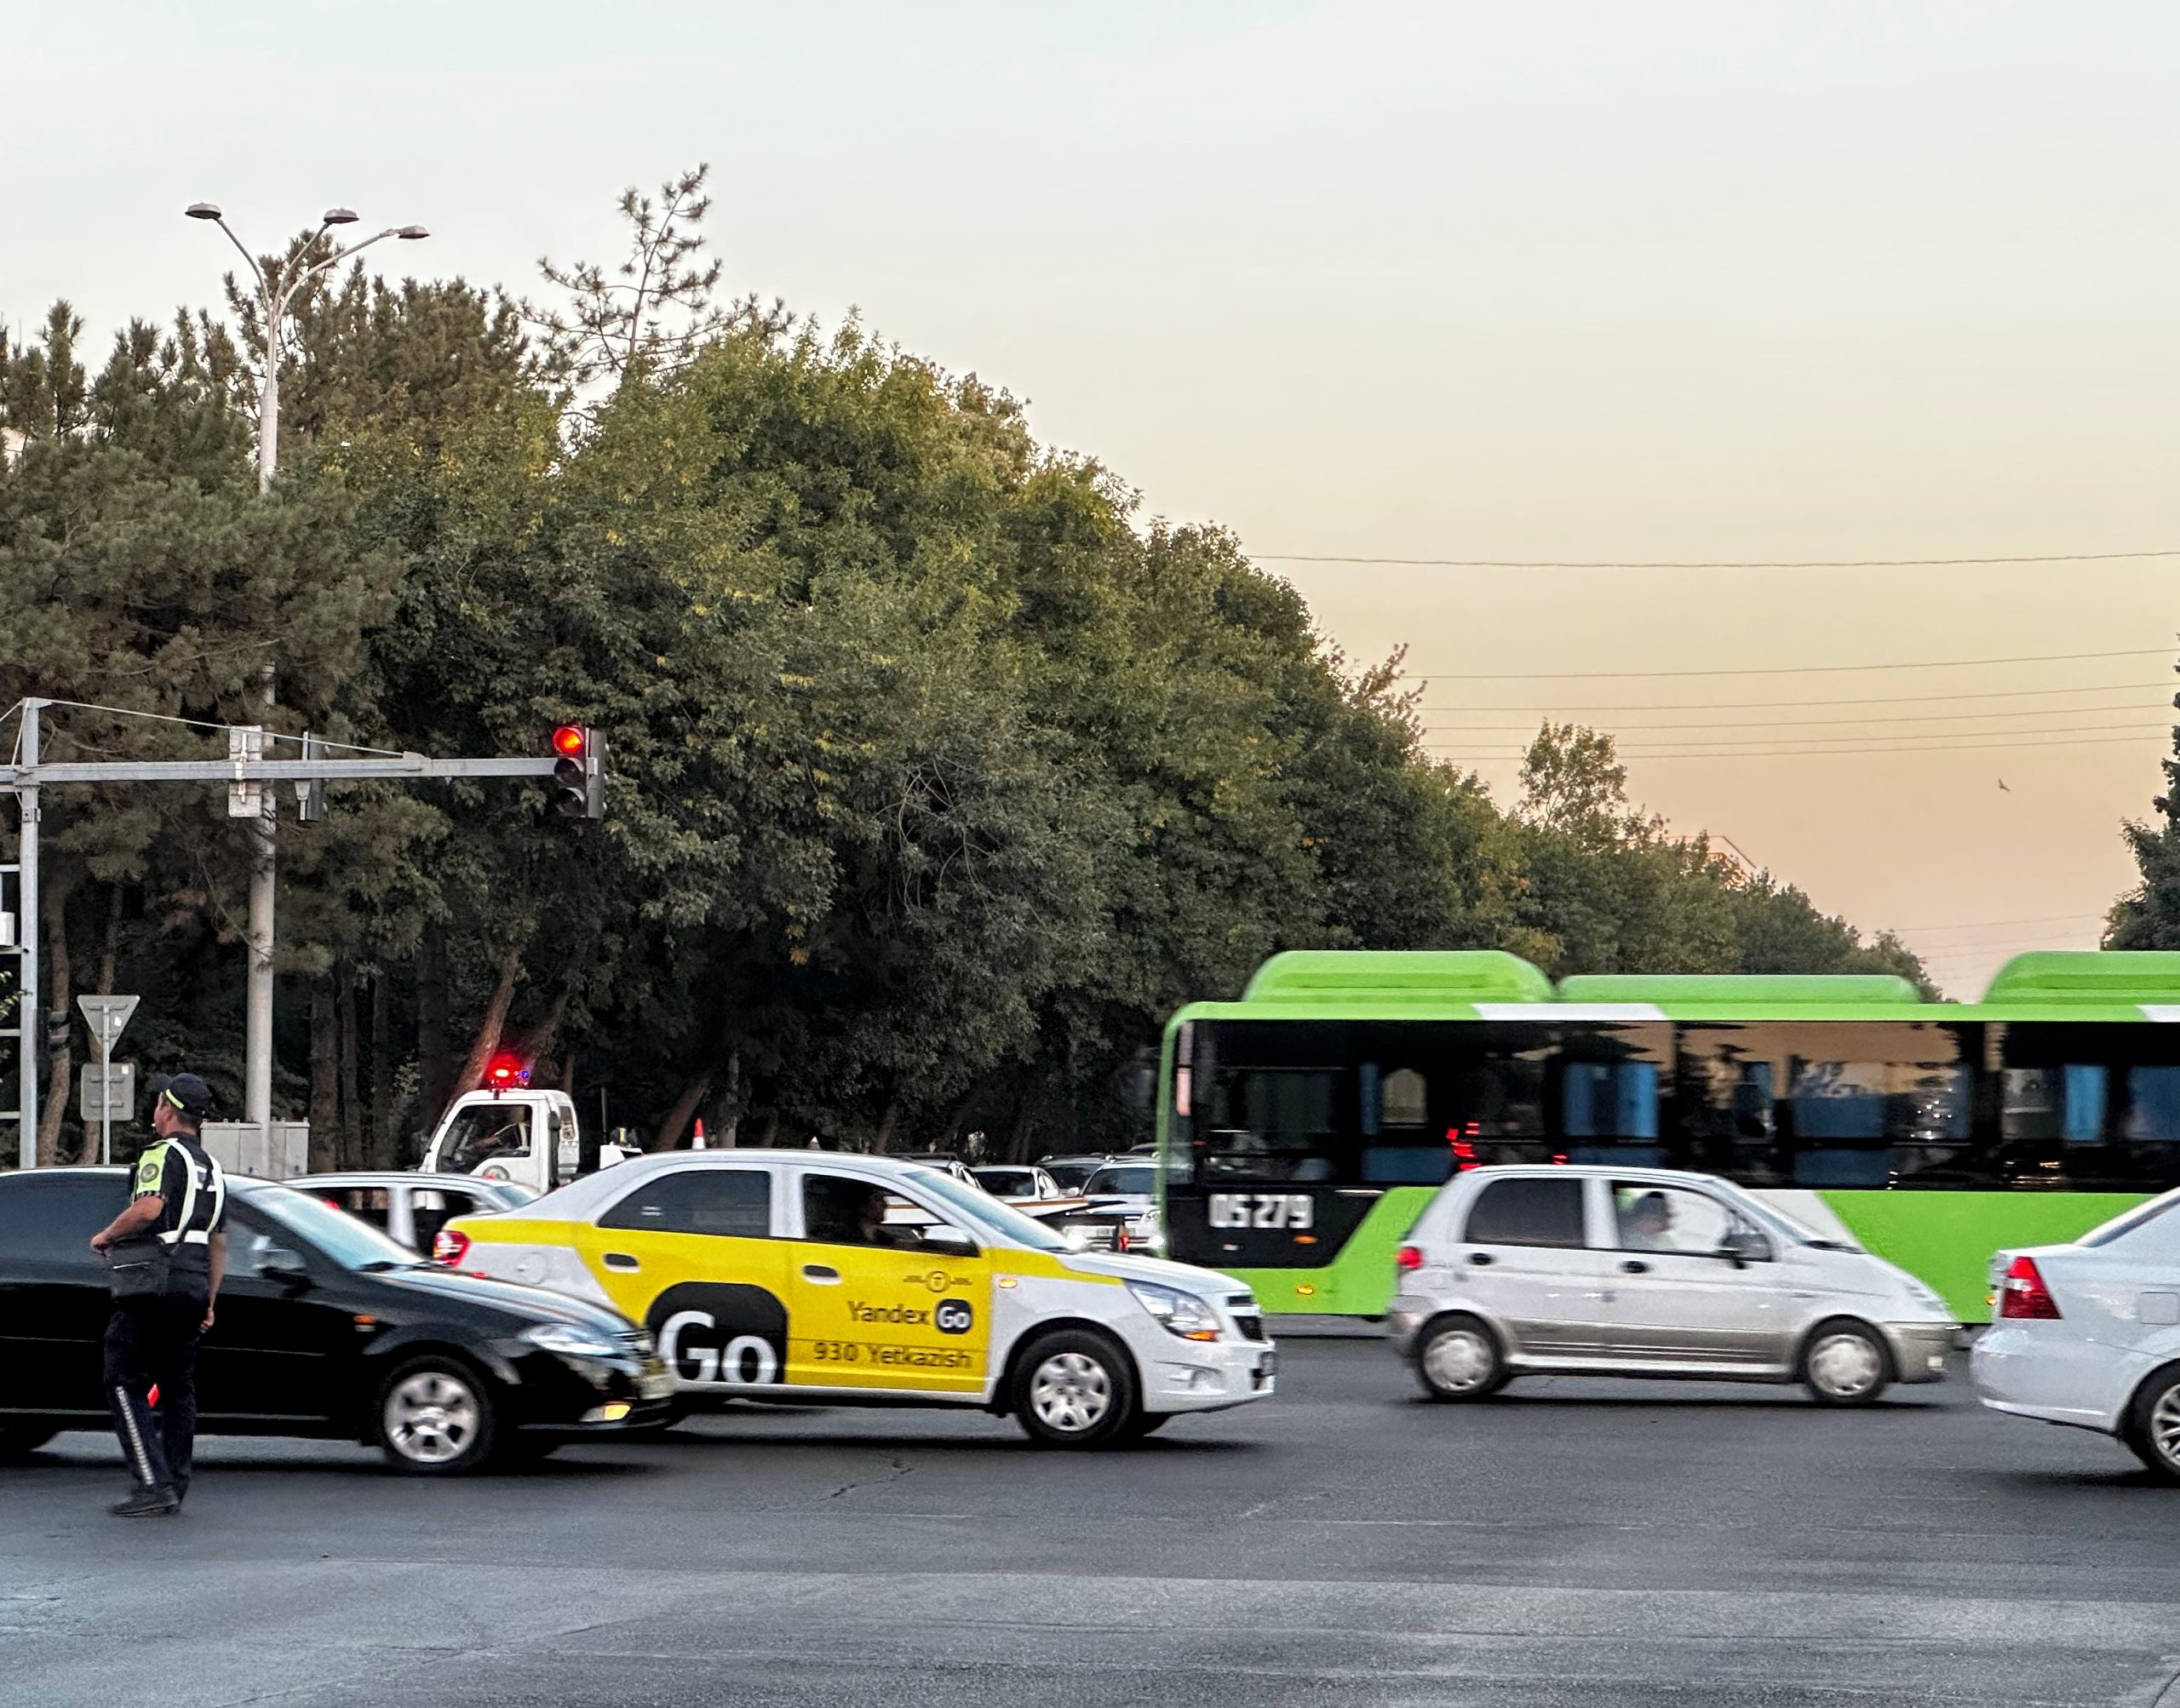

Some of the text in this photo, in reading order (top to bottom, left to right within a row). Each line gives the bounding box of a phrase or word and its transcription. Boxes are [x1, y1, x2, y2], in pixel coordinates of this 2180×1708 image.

[846, 1300, 972, 1329] Yandex Go
[657, 1310, 777, 1384] Go
[813, 1341, 973, 1369] 930 Yetkazish
